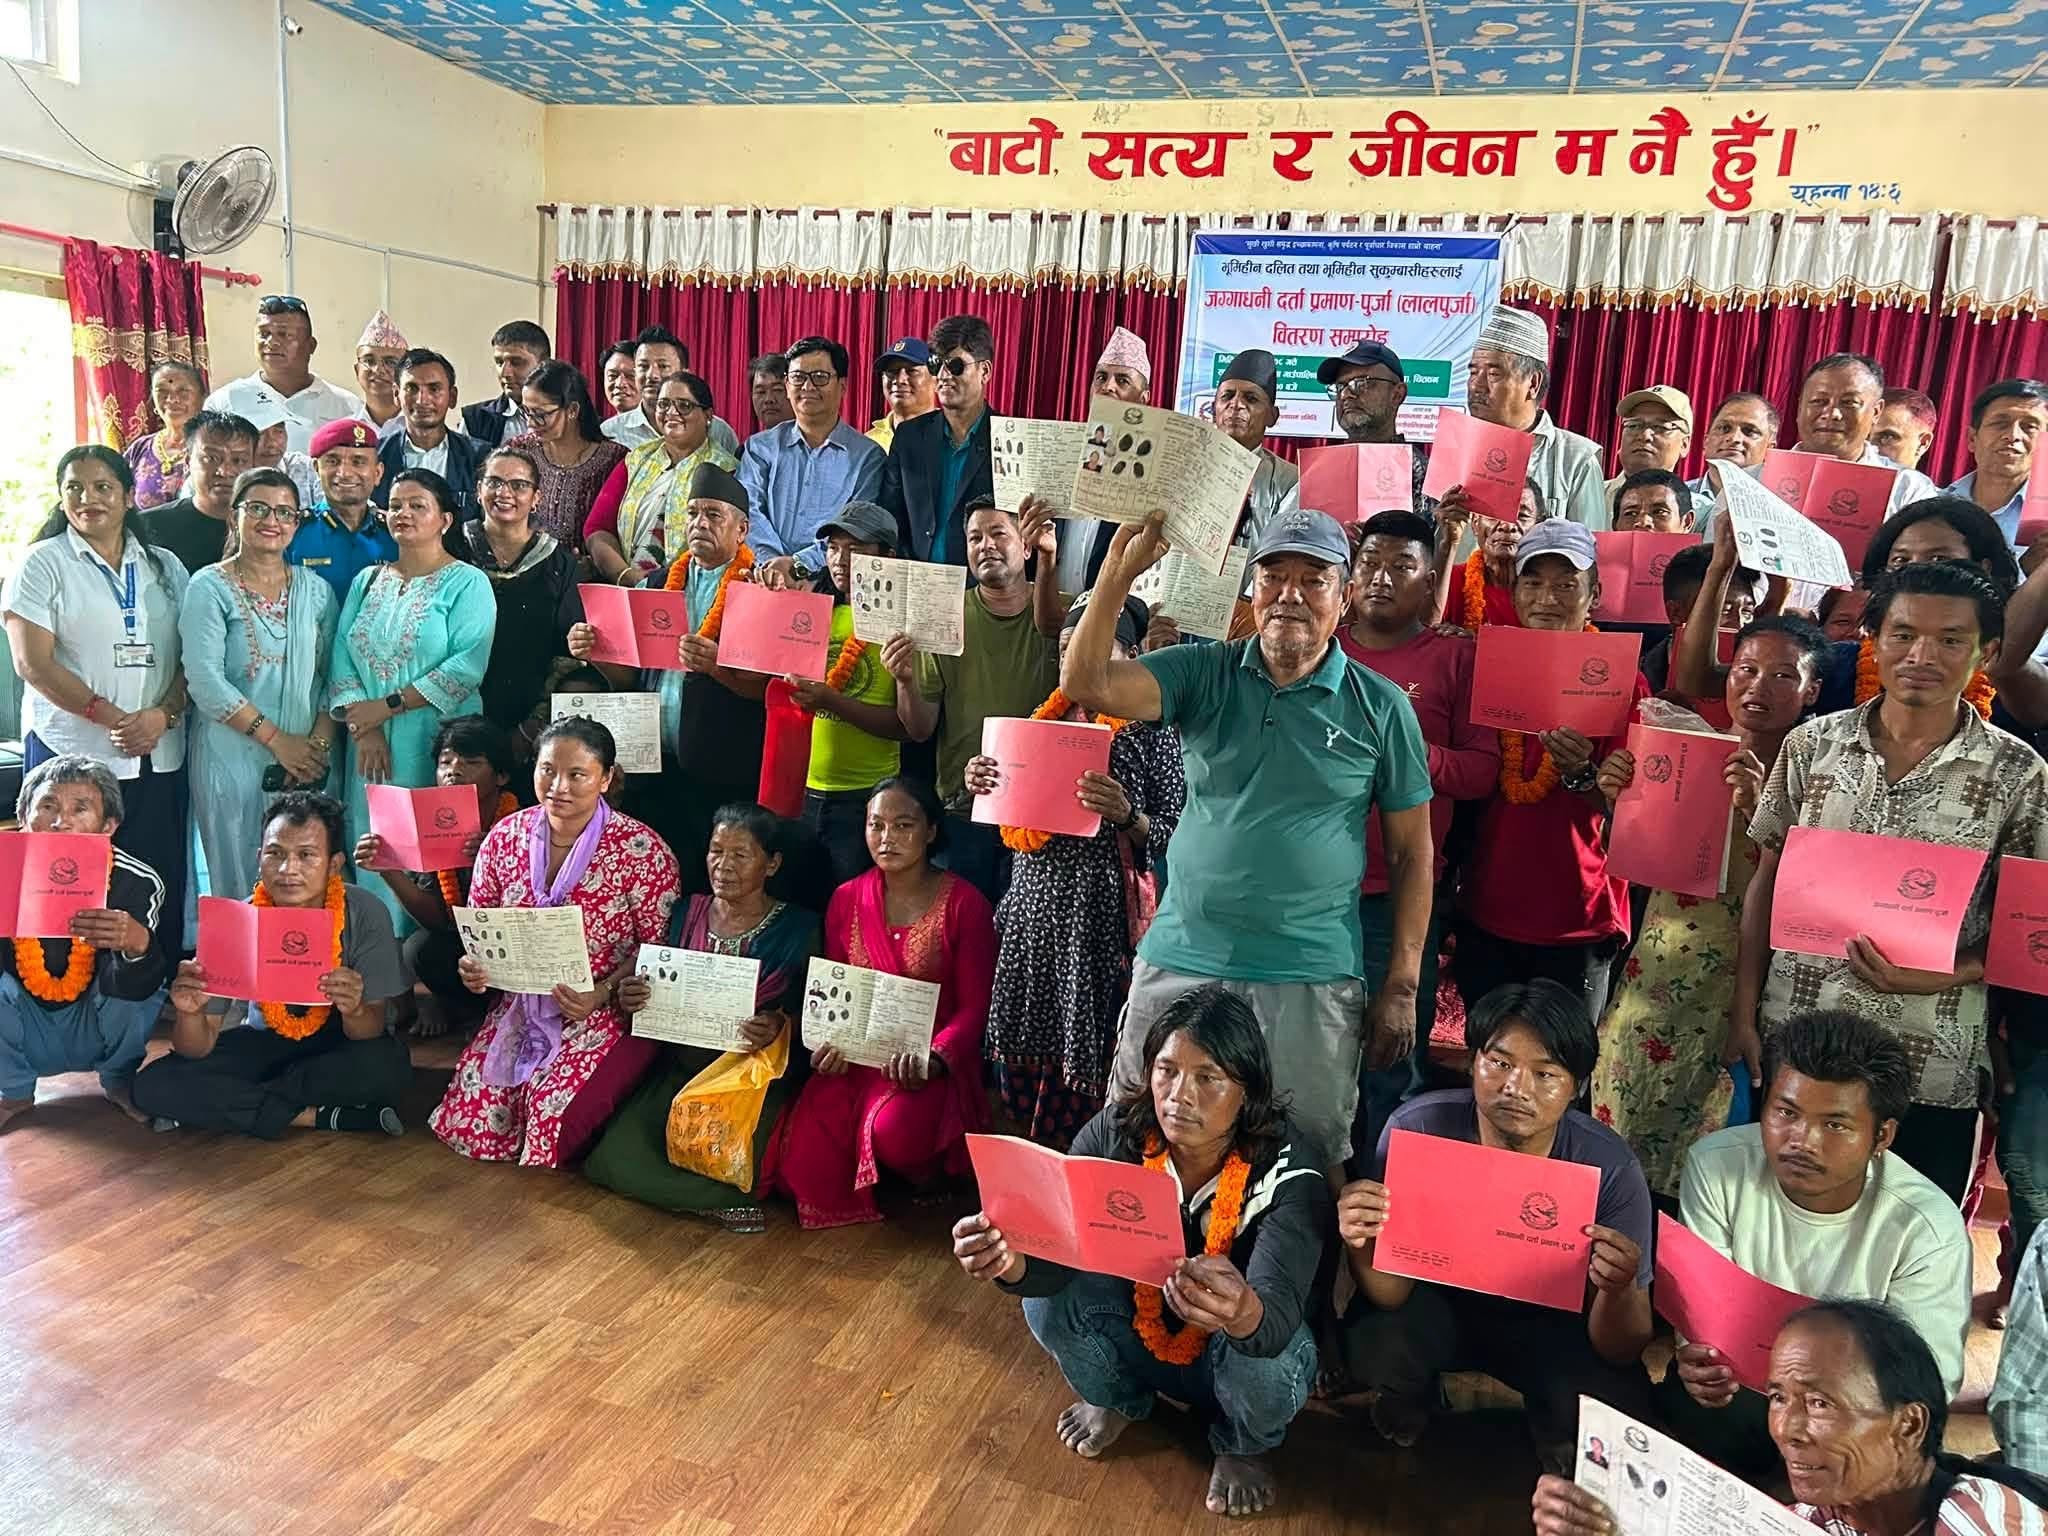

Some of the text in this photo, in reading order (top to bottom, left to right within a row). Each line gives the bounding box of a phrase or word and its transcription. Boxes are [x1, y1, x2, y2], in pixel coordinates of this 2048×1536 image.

[1081, 131, 1248, 181] सत्य
[1270, 131, 1333, 182] र
[1348, 110, 1538, 177] जीवन
[1554, 129, 1618, 176] म
[1628, 106, 1693, 176] नै
[1788, 183, 1852, 208] यूहन्ना
[1221, 258, 1262, 276] भूमिहीन
[1265, 260, 1295, 275] दलित
[1297, 263, 1321, 275] तथा
[1322, 260, 1366, 278] भूमिहीन
[1204, 286, 1272, 309] जग्गाधनी
[1276, 287, 1306, 310] दर्ता
[1397, 291, 1477, 318] (लालपुर्जा)
[1273, 321, 1325, 346] वितरण
